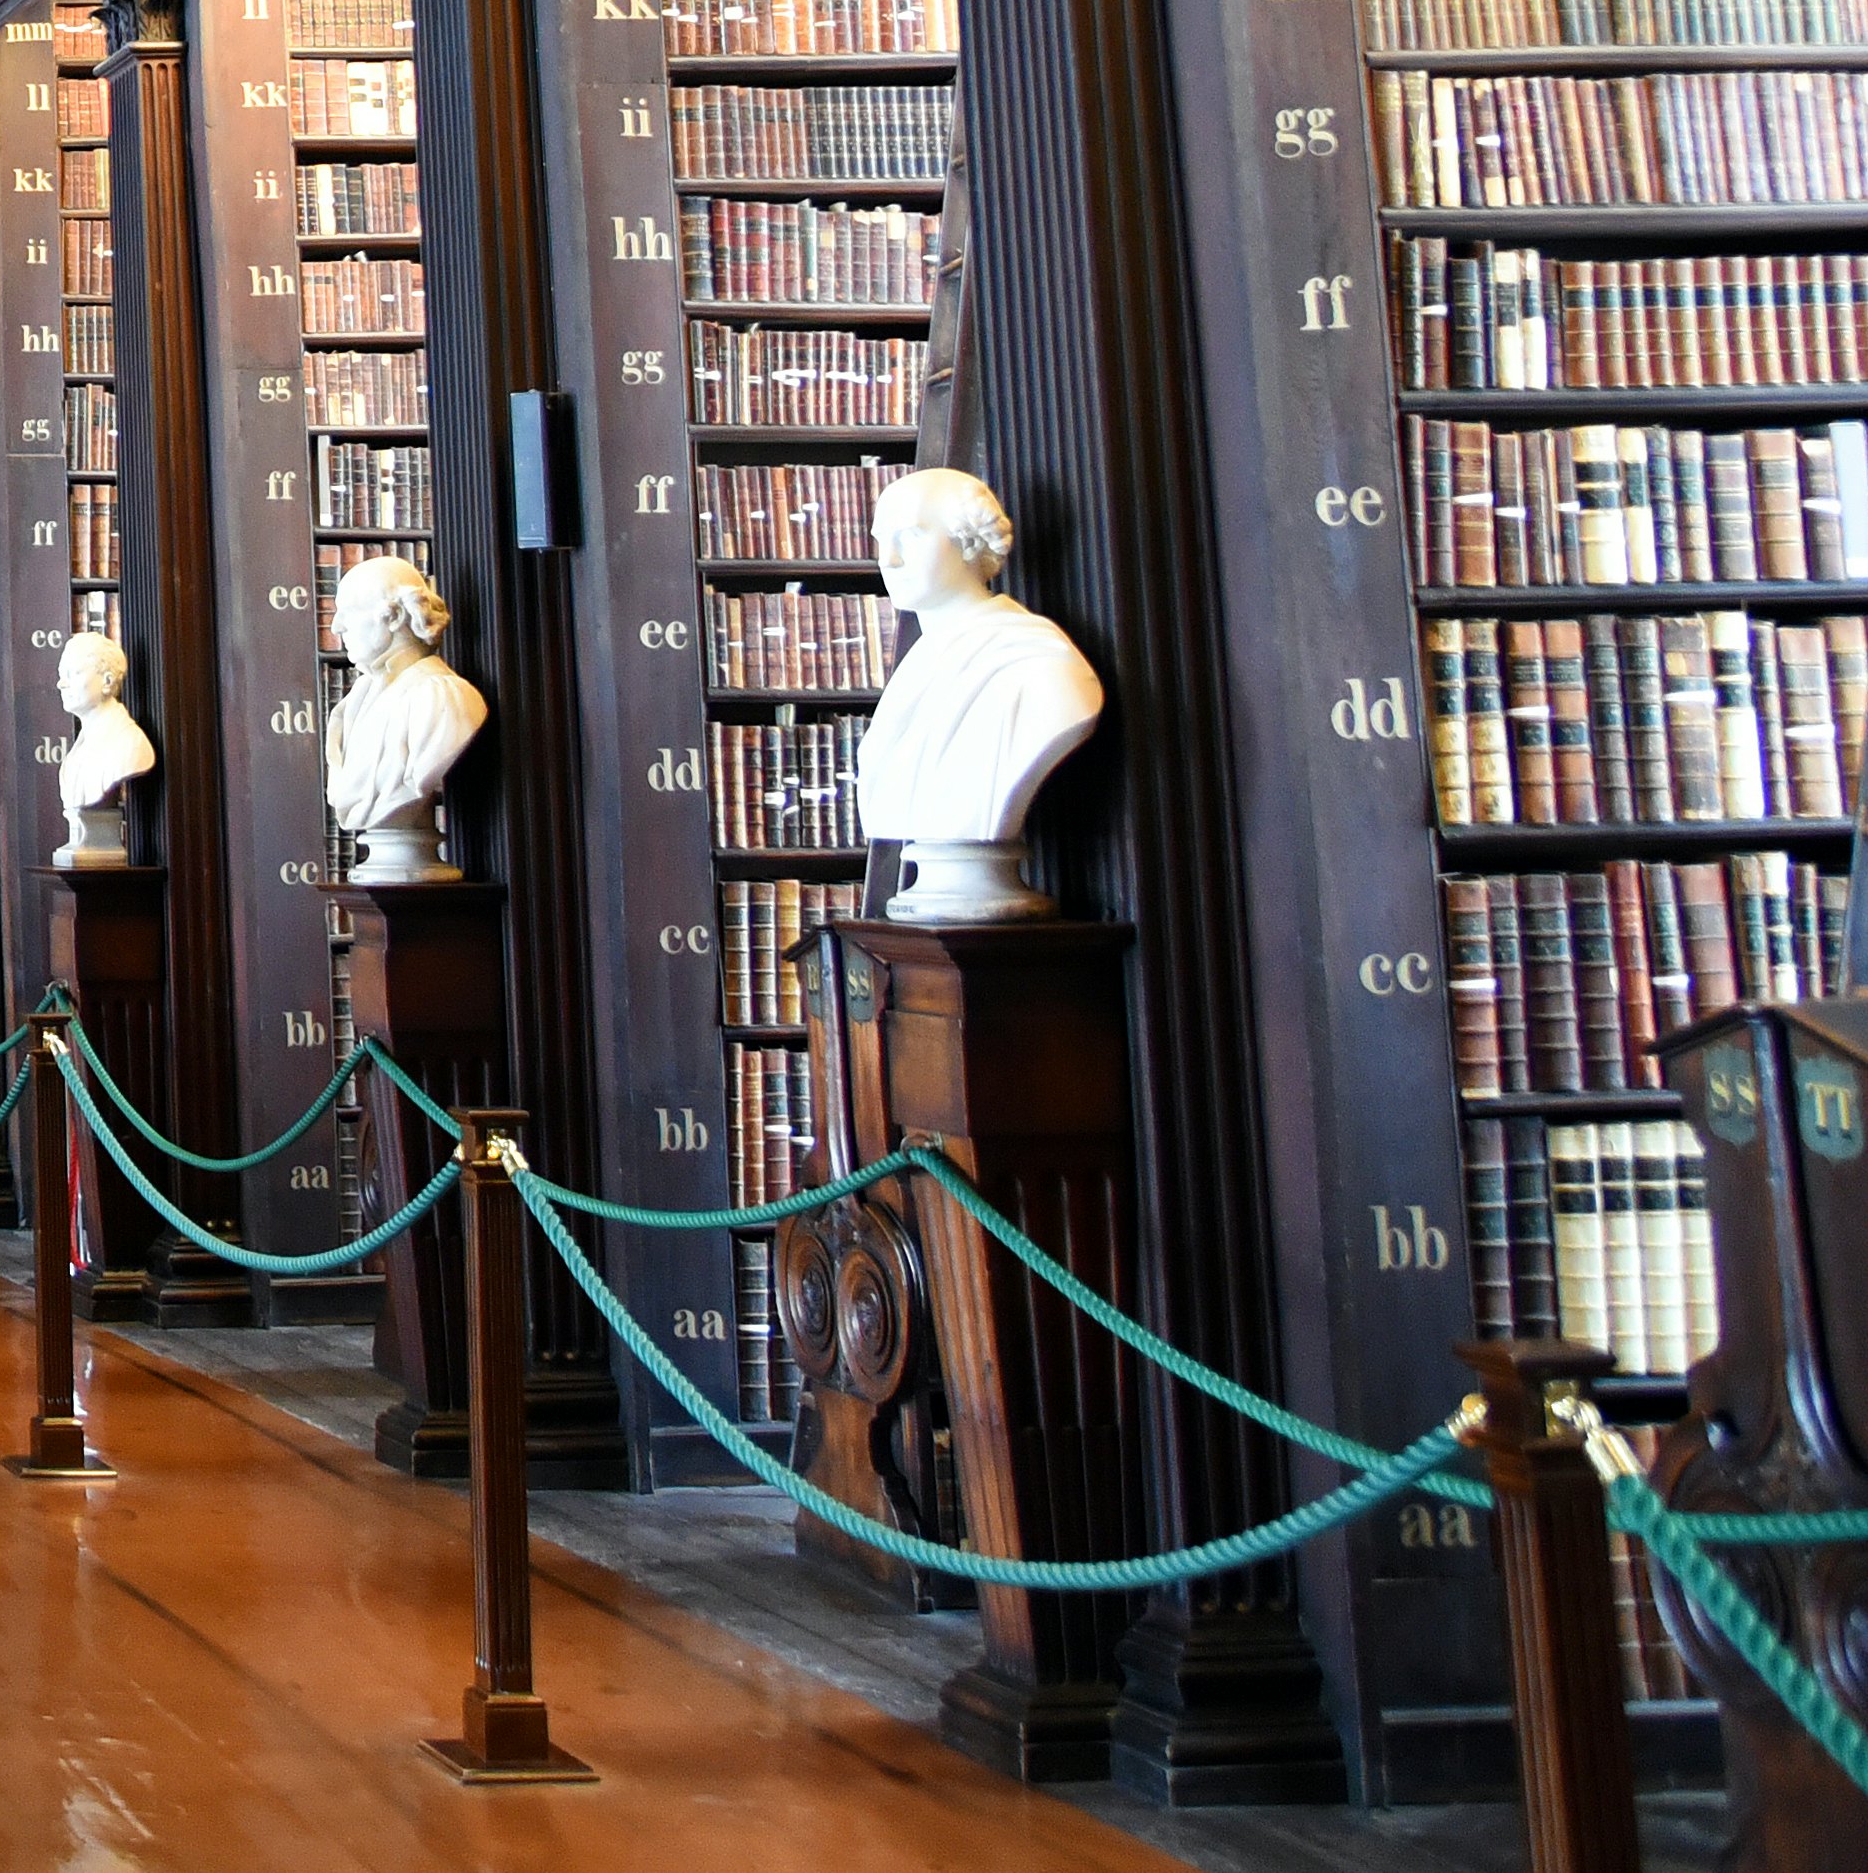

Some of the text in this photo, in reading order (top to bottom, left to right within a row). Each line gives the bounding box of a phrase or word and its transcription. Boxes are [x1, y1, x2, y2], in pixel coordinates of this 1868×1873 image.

[6, 23, 52, 42] mm
[26, 84, 50, 110] ll
[241, 82, 287, 107] kk
[620, 98, 652, 137] ii
[1275, 108, 1337, 158] gg
[14, 168, 53, 191] kk
[254, 171, 279, 199] ii
[27, 239, 47, 264] ii
[613, 217, 673, 260] hh
[248, 266, 295, 296] hh
[1298, 275, 1351, 330] ff
[22, 325, 59, 352] hh
[622, 351, 665, 384] gg
[259, 377, 291, 401] gg
[23, 419, 50, 440] gg
[266, 471, 296, 500] ff
[635, 475, 674, 513] ff
[1316, 487, 1383, 526] ee
[34, 521, 57, 545] ff
[269, 586, 308, 610] ee
[32, 630, 62, 648] ee
[640, 621, 687, 649] ee
[271, 701, 315, 734] dd
[1331, 678, 1409, 739] dd
[35, 736, 68, 764] dd
[648, 749, 702, 791] dd
[280, 862, 318, 884] cc
[660, 926, 709, 953] cc
[848, 968, 870, 997] SS
[1360, 953, 1429, 994] cc
[284, 1011, 325, 1046] bb
[1710, 1071, 1757, 1115] SS
[1805, 1082, 1855, 1130] TT
[655, 1109, 708, 1151] bb
[291, 1166, 329, 1189] aa
[1371, 1206, 1448, 1270] bb
[675, 1310, 725, 1340] aa
[1402, 1504, 1474, 1547] aa
